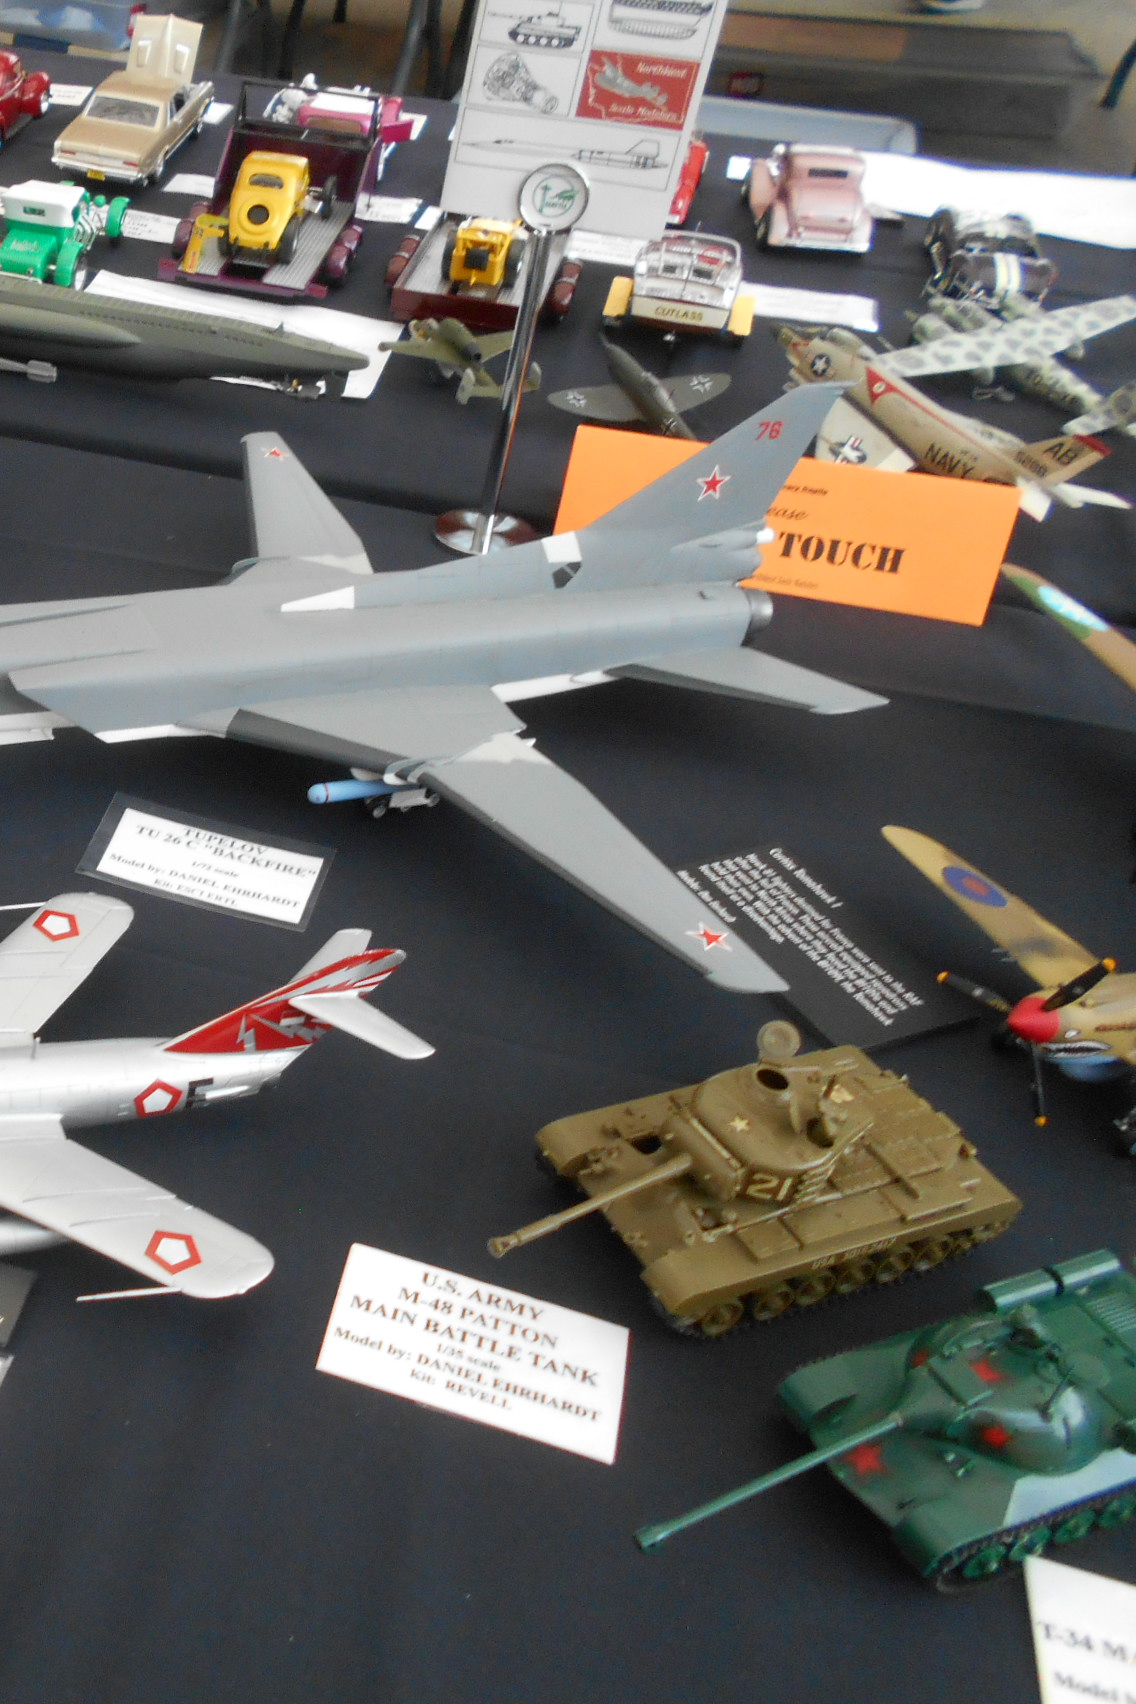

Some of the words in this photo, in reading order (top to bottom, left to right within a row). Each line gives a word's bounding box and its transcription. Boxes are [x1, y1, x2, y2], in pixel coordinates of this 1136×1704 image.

[654, 306, 703, 322] CUTLASS
[756, 421, 784, 440] 76
[923, 442, 976, 480] NAVY
[766, 506, 808, 521] ease
[778, 531, 906, 574] TOUCH
[137, 824, 160, 840] TU
[164, 833, 182, 846] 26
[186, 838, 198, 850] C
[184, 827, 268, 856] TUPELOV
[110, 852, 146, 869] Model
[168, 869, 219, 890] DANIEL
[223, 884, 300, 909] EHRHARDT
[746, 1172, 793, 1201] 21
[421, 1271, 462, 1297] U.S.
[468, 1289, 544, 1322] ARMY
[398, 1286, 454, 1316] M-48
[460, 1308, 558, 1350] PATTON
[350, 1294, 418, 1327] MAIN
[424, 1317, 522, 1362] BATTLE
[528, 1350, 601, 1388] TANK
[436, 1342, 465, 1360] 1/35
[468, 1354, 502, 1372] scale
[333, 1326, 384, 1351] Model
[387, 1342, 412, 1362] by:
[416, 1353, 488, 1387] DANIEL
[492, 1376, 602, 1422] EHRHARDT
[410, 1368, 436, 1385] Kit:
[445, 1379, 513, 1411] REVELL
[1036, 1620, 1094, 1652] T-34
[1101, 1639, 1136, 1662] M
